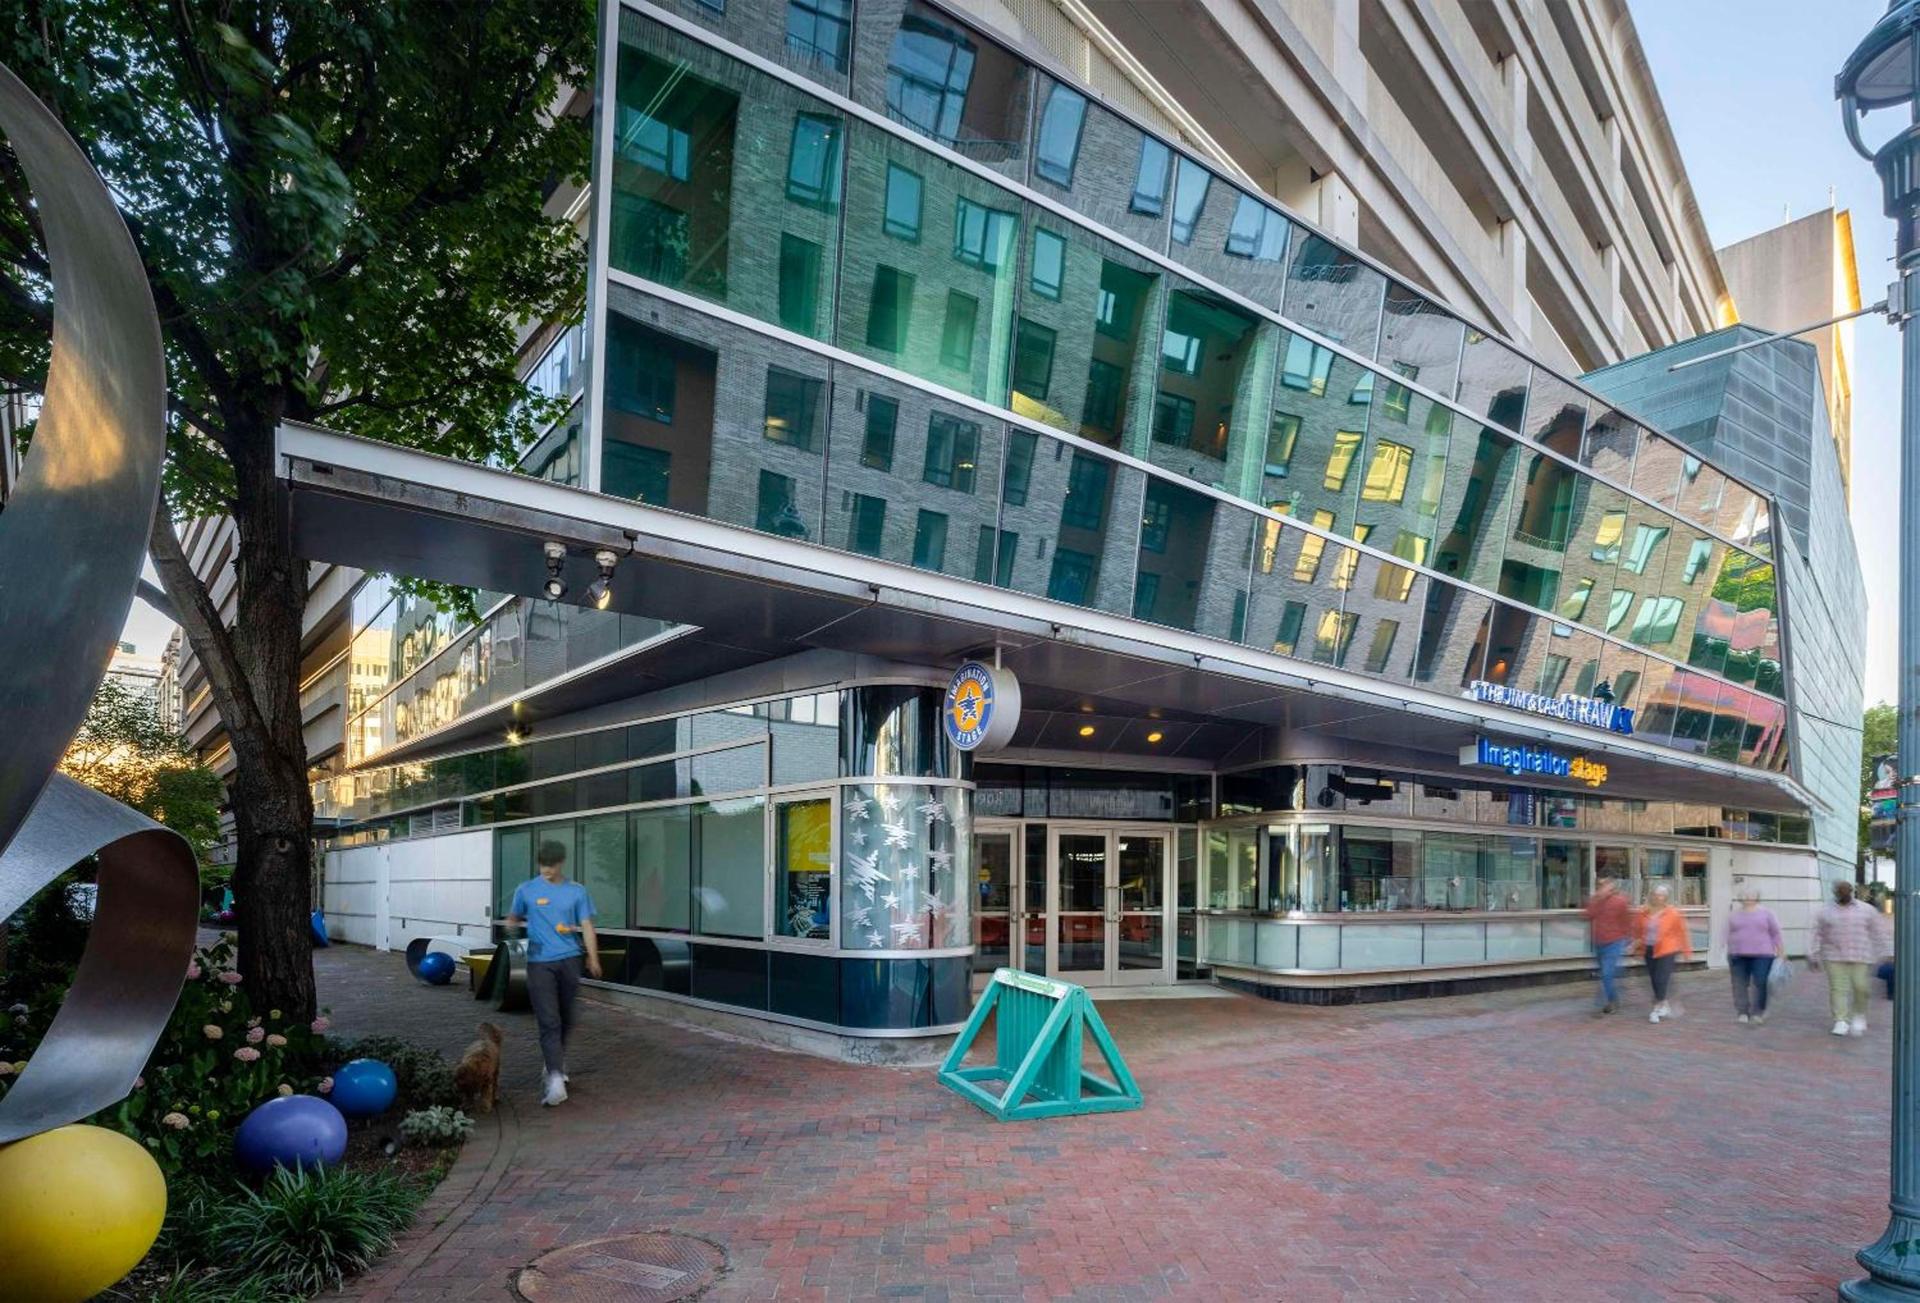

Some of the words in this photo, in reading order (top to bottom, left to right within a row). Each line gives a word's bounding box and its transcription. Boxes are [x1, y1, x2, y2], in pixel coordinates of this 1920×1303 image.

[950, 668, 990, 700] IMAGINATION
[1477, 681, 1504, 704] THE
[1504, 687, 1526, 708] JIM
[1528, 694, 1537, 712] &
[956, 726, 983, 742] STAGE
